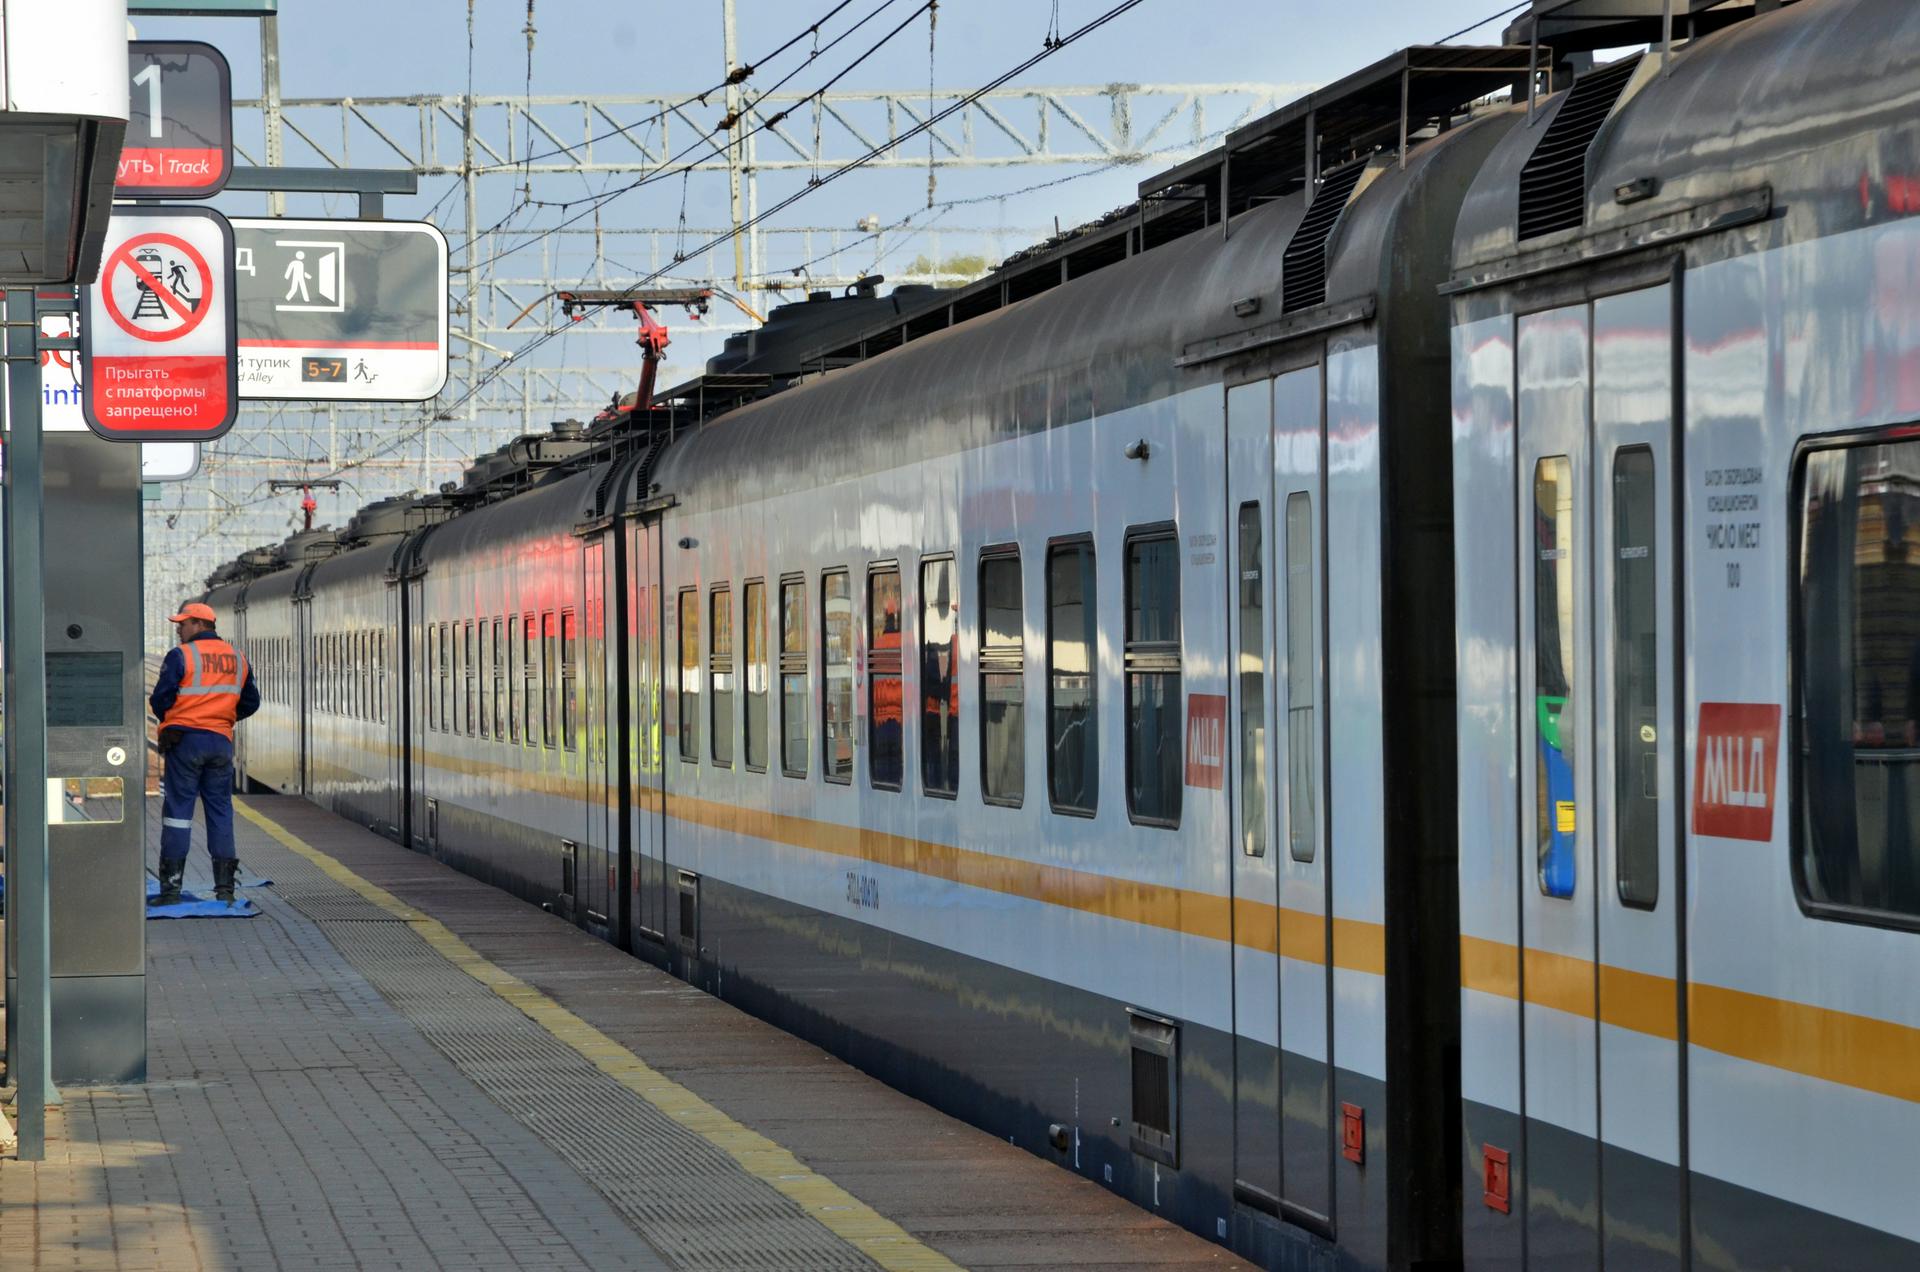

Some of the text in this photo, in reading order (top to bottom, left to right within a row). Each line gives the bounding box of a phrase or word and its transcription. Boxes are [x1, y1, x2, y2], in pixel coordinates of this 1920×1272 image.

[132, 64, 162, 137] 1
[168, 159, 210, 174] Track
[249, 357, 291, 371] тупик
[105, 366, 170, 380] Прыгать
[247, 372, 274, 384] Alley
[105, 385, 206, 401] с платформы
[105, 403, 199, 420] запрещено!
[1705, 522, 1761, 549] ЧИСЛО МЕСТ
[1702, 735, 1767, 808] МЦД
